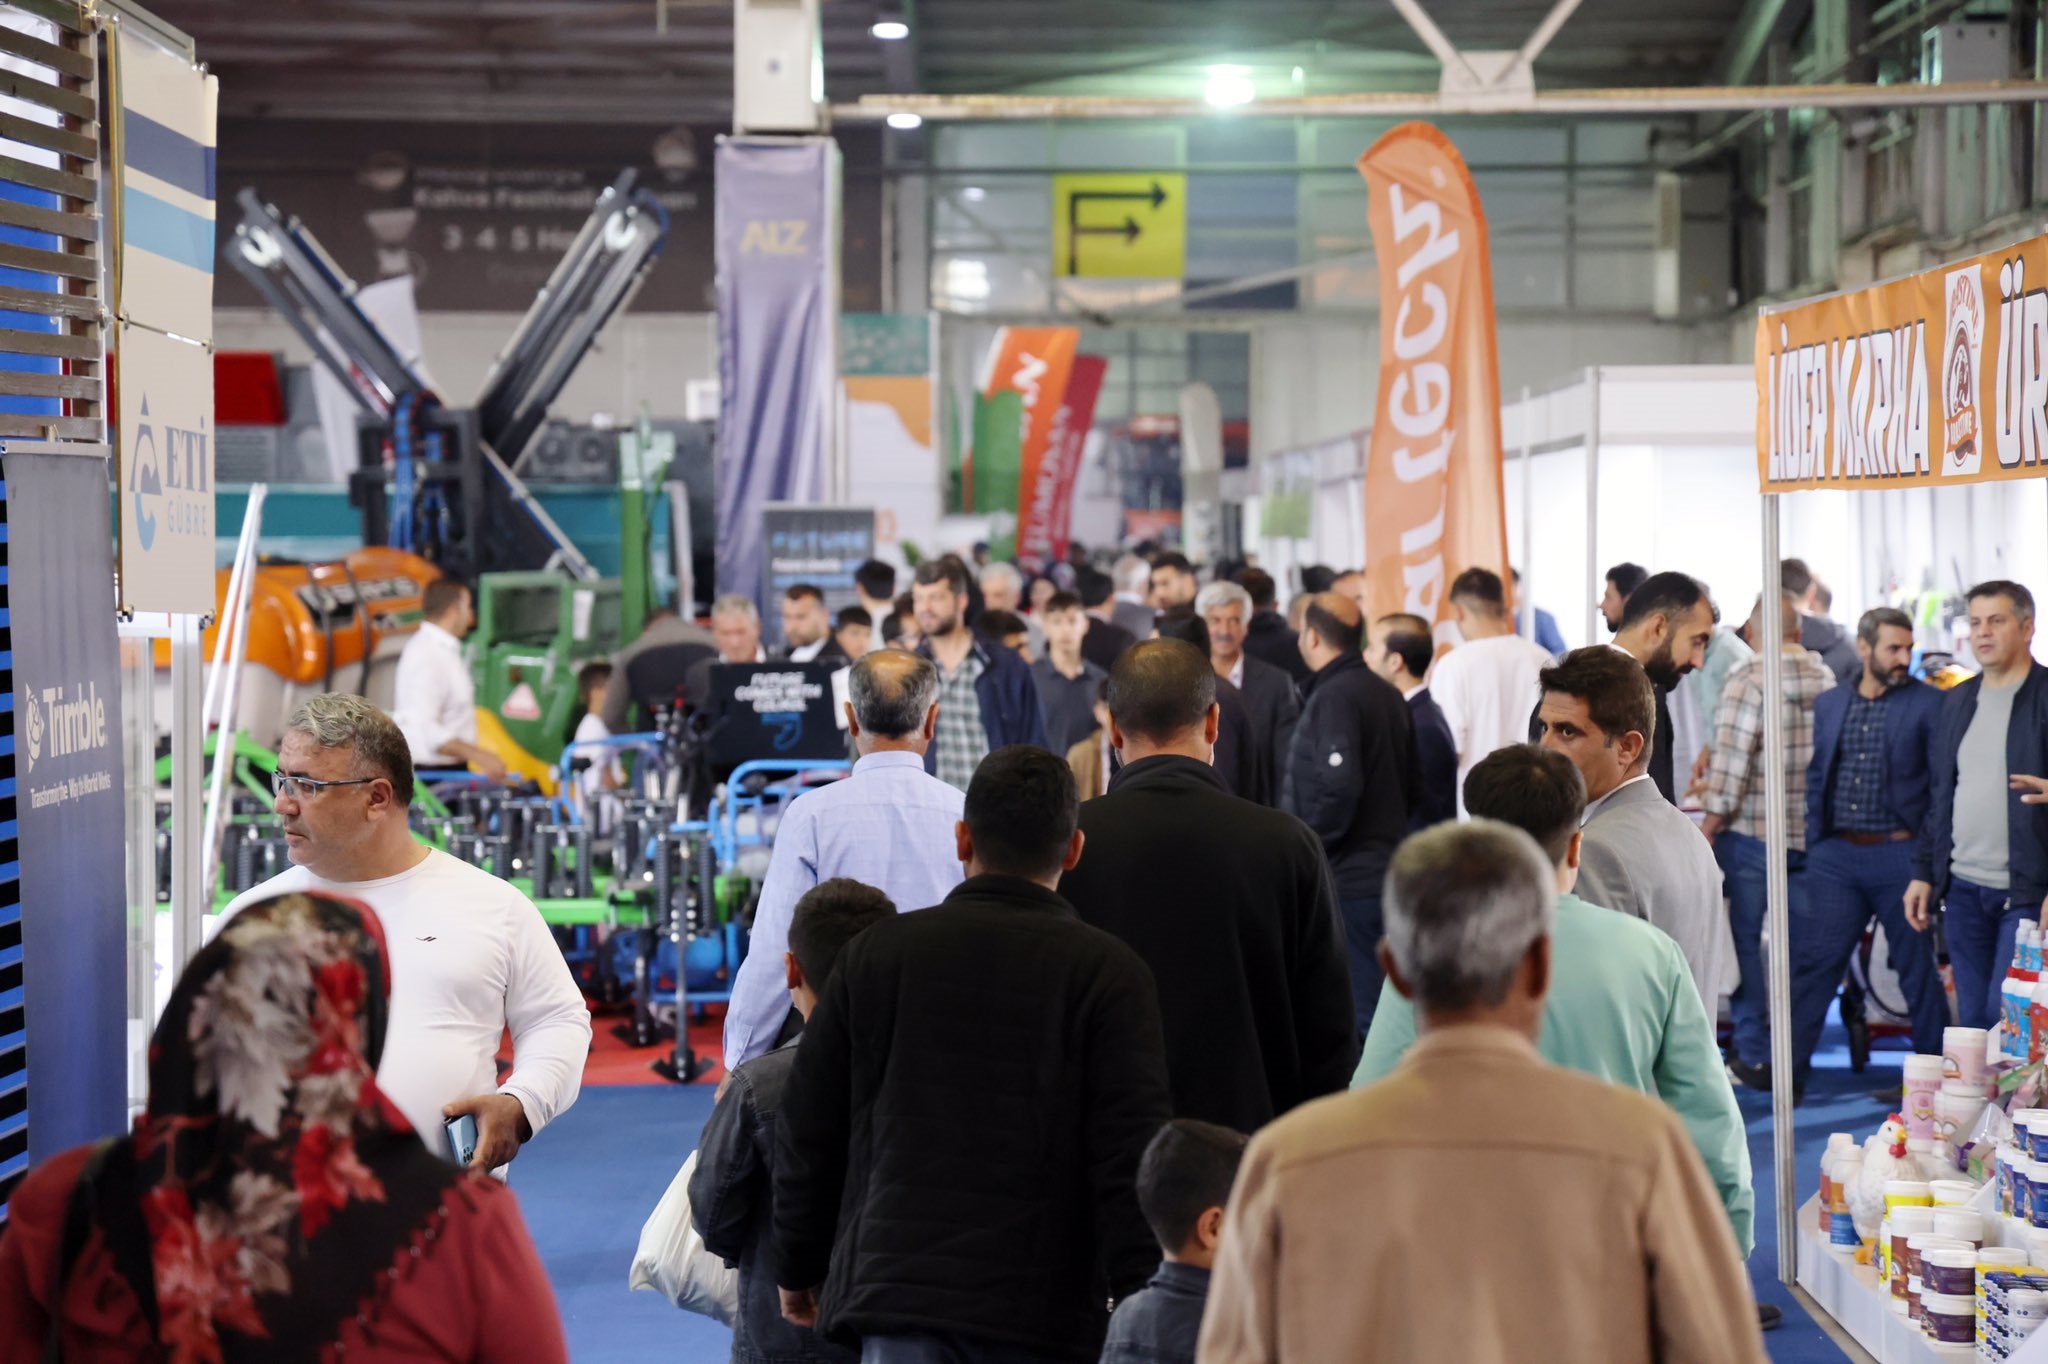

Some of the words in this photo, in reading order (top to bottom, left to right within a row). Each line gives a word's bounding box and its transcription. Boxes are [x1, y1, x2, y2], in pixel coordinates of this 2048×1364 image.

[1768, 320, 1827, 482] LİDER
[1831, 318, 1930, 480] MARKA
[165, 415, 208, 493] ETİ
[168, 495, 207, 537] GÜBRE
[43, 681, 106, 758] Trimble
